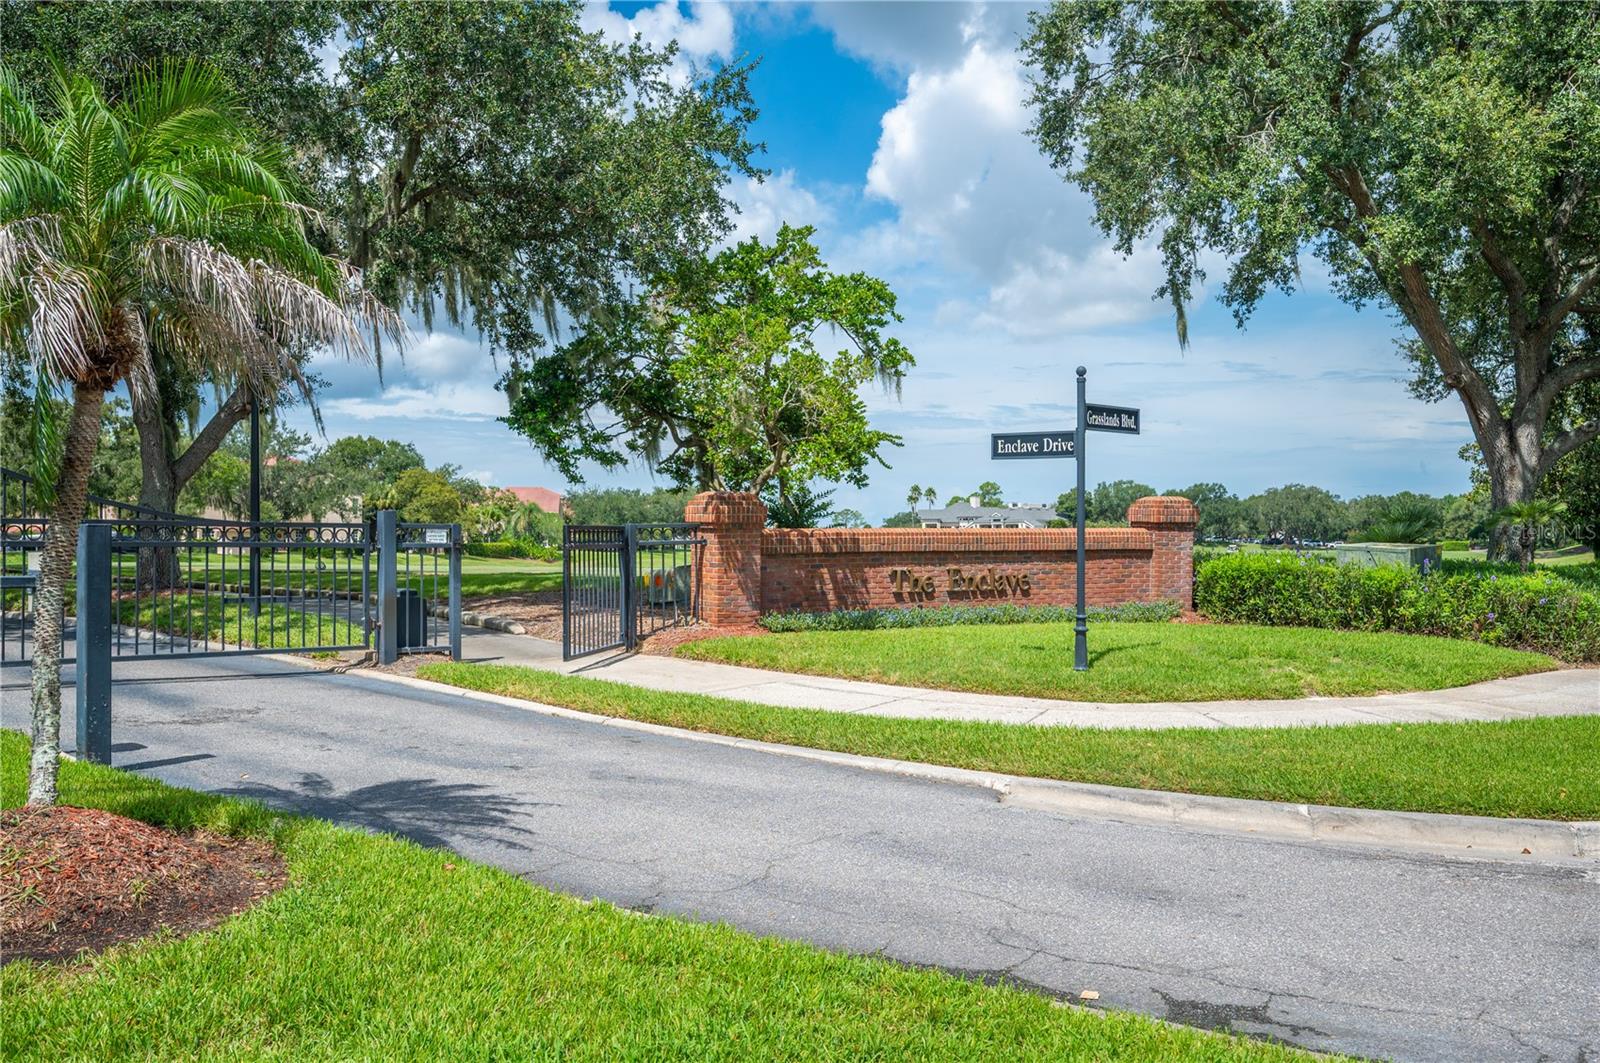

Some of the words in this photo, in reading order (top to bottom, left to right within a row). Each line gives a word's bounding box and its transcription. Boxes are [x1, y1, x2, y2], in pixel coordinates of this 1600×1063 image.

[1086, 410, 1120, 427] Grasslands
[1121, 413, 1137, 429] Blvd.
[998, 438, 1039, 453] Enclave
[1043, 437, 1074, 452] Drive
[890, 566, 935, 592] The
[946, 566, 1031, 592] Enclave
